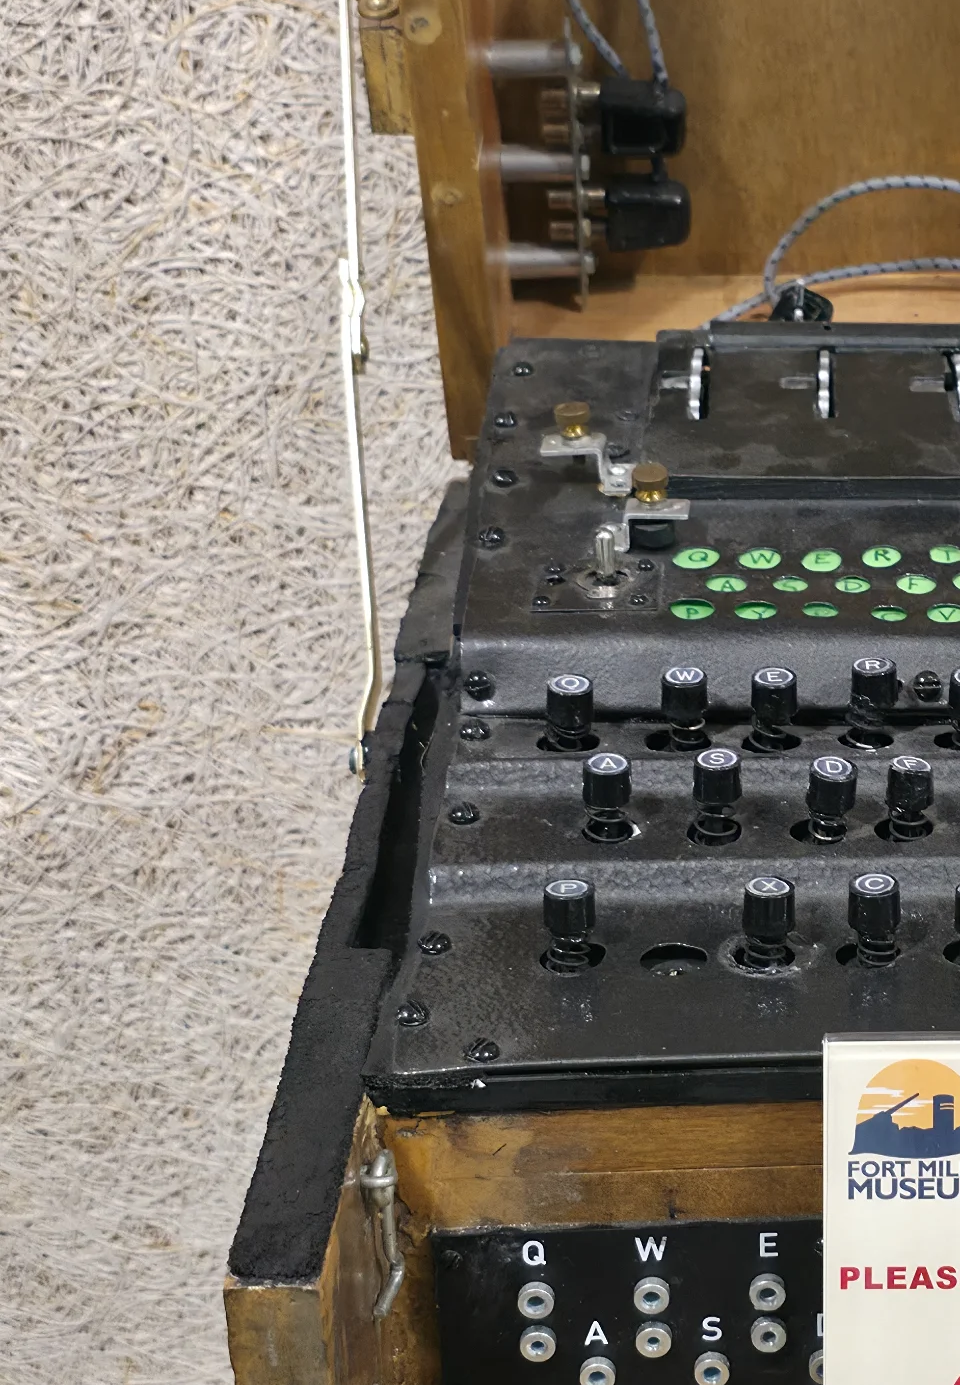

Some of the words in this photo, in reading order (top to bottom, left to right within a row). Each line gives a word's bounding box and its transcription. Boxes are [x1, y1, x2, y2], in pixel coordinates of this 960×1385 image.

[688, 550, 709, 562] Q
[749, 552, 775, 564] W
[814, 553, 832, 564] E
[874, 549, 892, 562] R
[720, 579, 737, 592] A
[843, 581, 863, 593] D
[907, 577, 923, 590] F
[676, 670, 695, 682] W
[767, 671, 783, 683] E
[865, 659, 881, 671] R
[599, 758, 618, 769] A
[708, 753, 725, 764] S
[825, 760, 843, 773] D
[903, 758, 918, 769] F
[560, 883, 577, 893] P
[762, 881, 778, 891] X
[864, 878, 884, 889] C
[848, 1160, 912, 1178] FORT
[522, 1240, 546, 1266] Q
[635, 1236, 667, 1262] W
[759, 1232, 779, 1257] E
[585, 1320, 609, 1346] A
[702, 1317, 723, 1341] S
